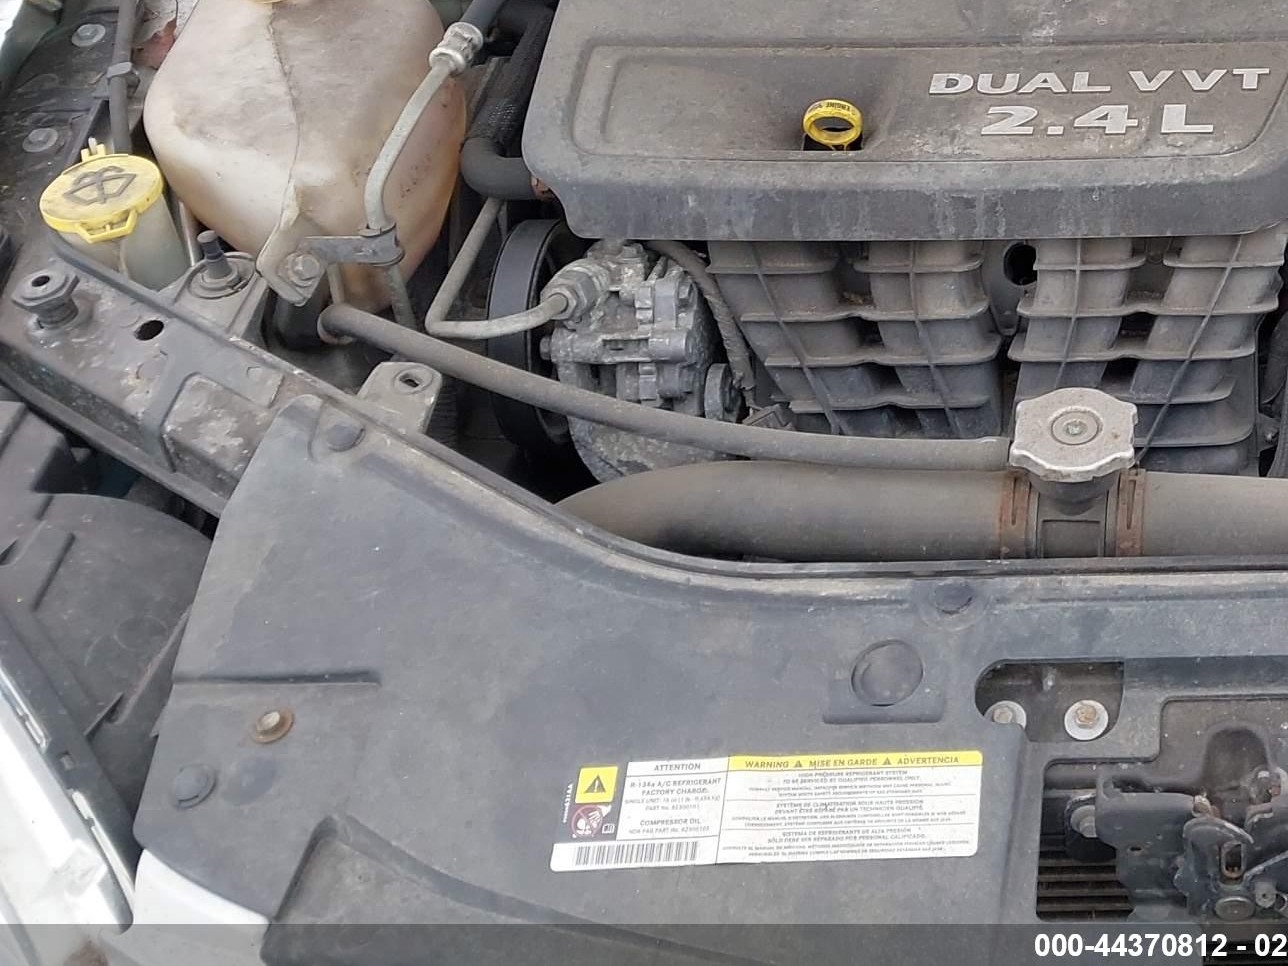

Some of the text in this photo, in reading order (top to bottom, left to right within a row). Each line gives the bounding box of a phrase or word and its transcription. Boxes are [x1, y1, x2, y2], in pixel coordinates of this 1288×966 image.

[929, 68, 1270, 95] DUAL VVT
[981, 104, 1214, 136] 2.4 L
[654, 762, 701, 771] ATTENTION
[745, 761, 790, 769] WARNING
[809, 759, 831, 767] MISE
[848, 758, 878, 766] GARDE
[897, 756, 960, 765] ADVERTENCIA
[657, 778, 672, 787] A/C
[673, 777, 722, 786] REFRIGERANT
[641, 787, 675, 796] FACTORY
[640, 817, 701, 826] COMPRESSOR OIL
